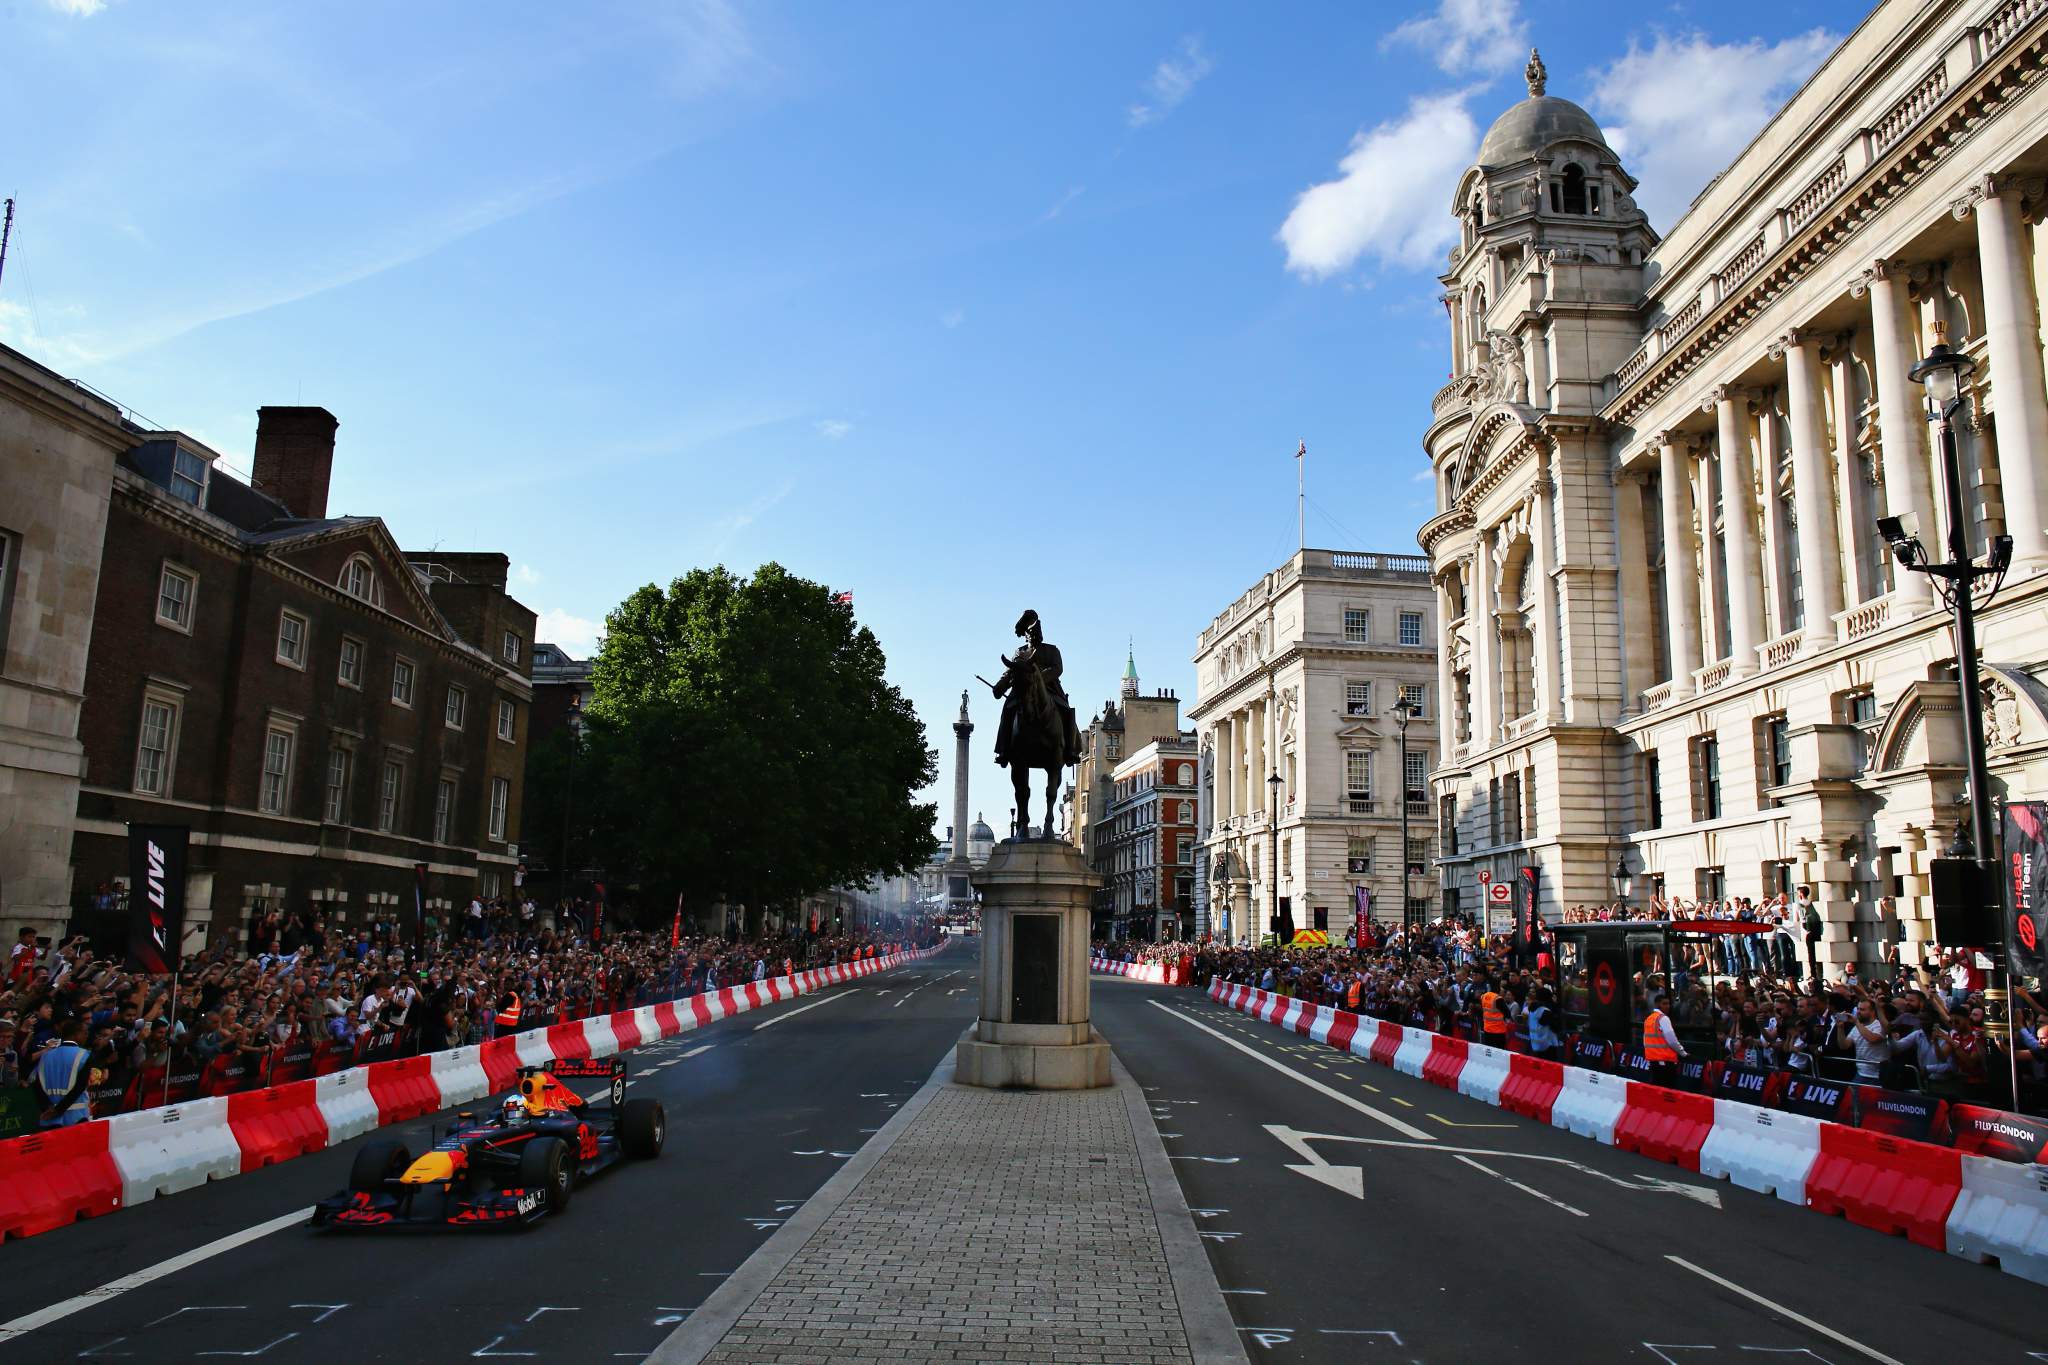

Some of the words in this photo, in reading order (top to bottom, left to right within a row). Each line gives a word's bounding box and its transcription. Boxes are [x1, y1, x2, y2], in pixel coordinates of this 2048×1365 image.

[148, 839, 165, 910] LIVE
[1482, 871, 1489, 881] P
[2022, 852, 2031, 890] Team
[2013, 852, 2023, 909] Haas
[2022, 894, 2031, 909] F1
[378, 1031, 395, 1047] LIVE
[1584, 1042, 1604, 1057] LIVE
[1631, 1055, 1650, 1070] LIVE
[1682, 1062, 1704, 1078] LIVE
[1738, 1072, 1764, 1091] LIVE
[1804, 1084, 1840, 1106] LIVE
[517, 1192, 536, 1215] Mobil
[1253, 1333, 1292, 1349] P
